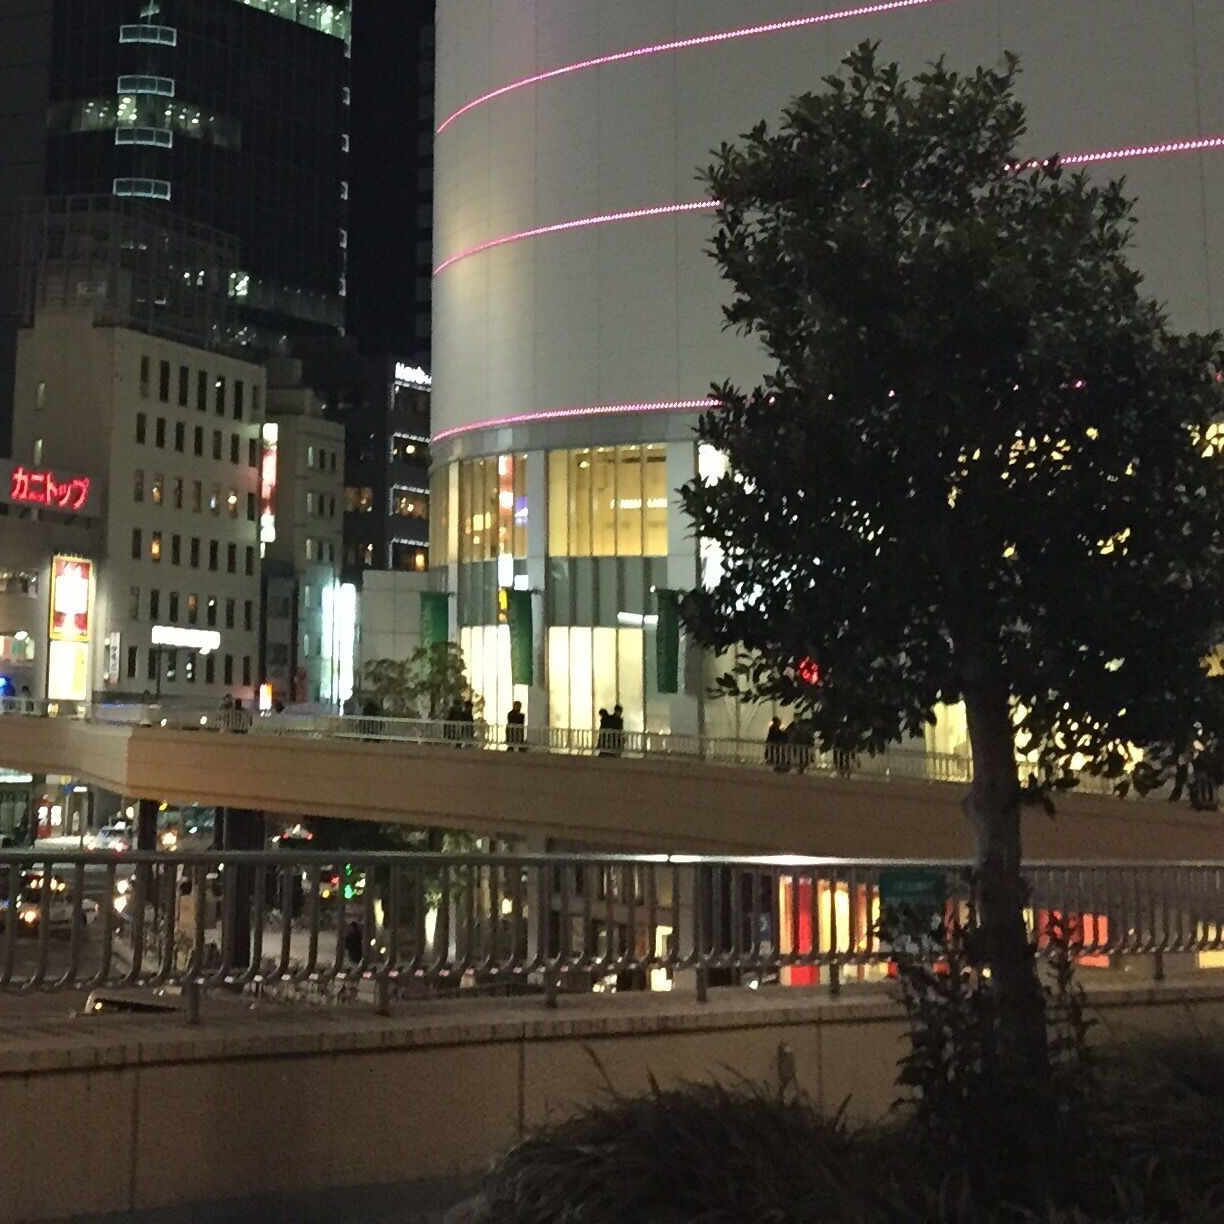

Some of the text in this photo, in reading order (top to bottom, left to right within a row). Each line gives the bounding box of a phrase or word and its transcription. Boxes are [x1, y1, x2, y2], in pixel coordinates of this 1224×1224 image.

[11, 466, 91, 510] カニトップ
